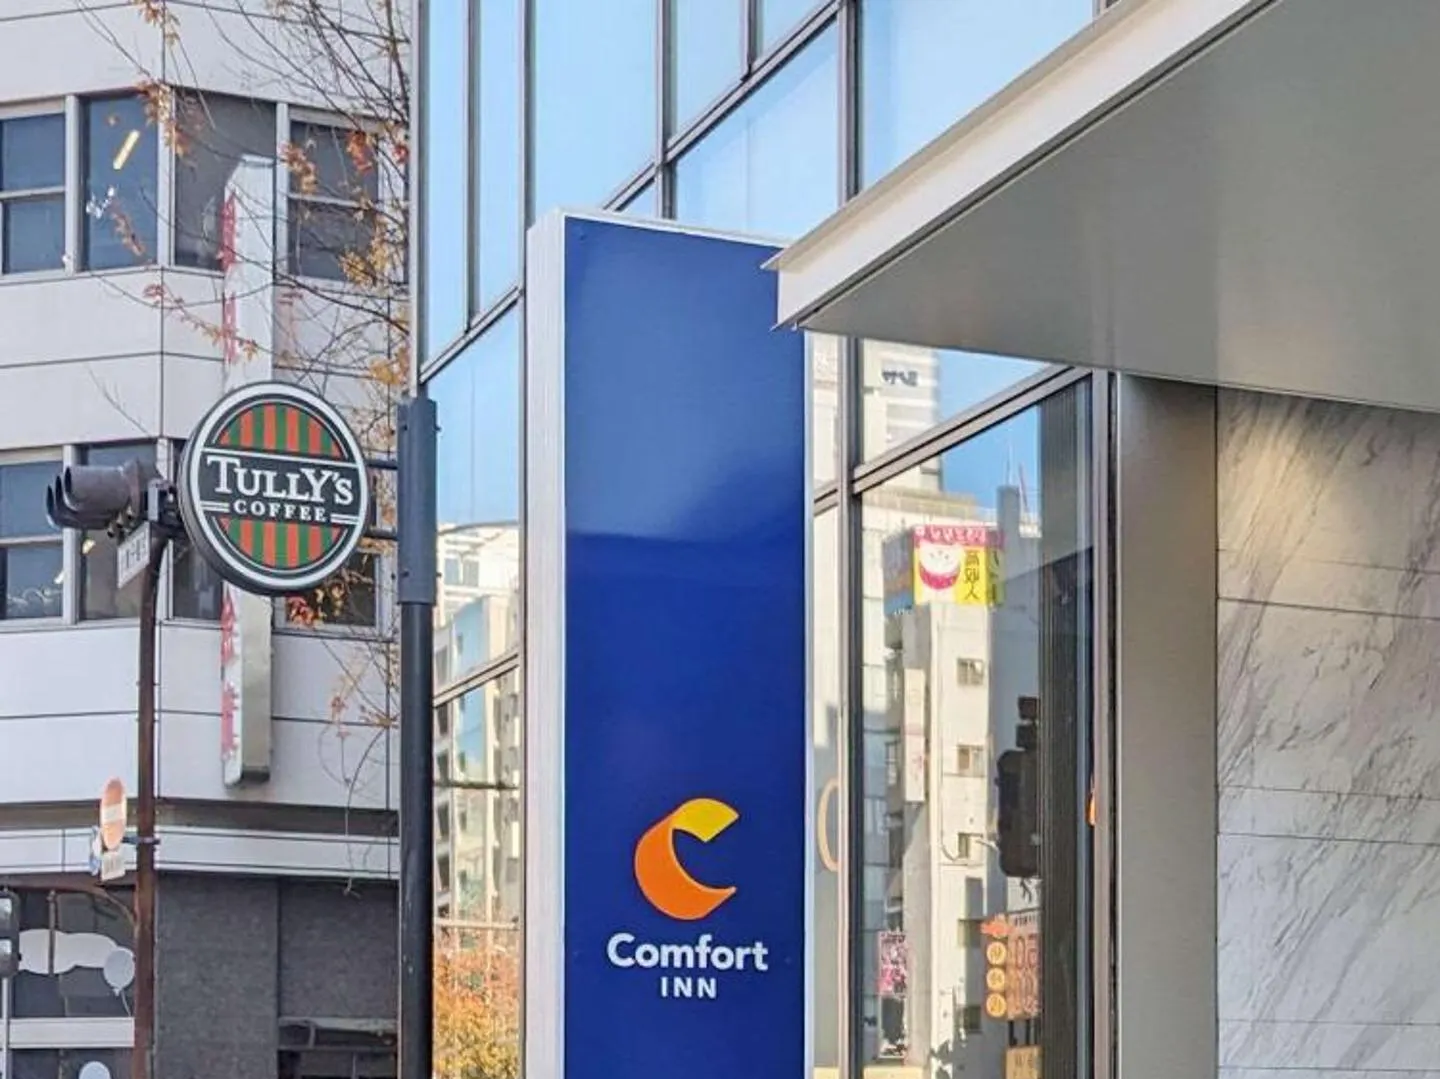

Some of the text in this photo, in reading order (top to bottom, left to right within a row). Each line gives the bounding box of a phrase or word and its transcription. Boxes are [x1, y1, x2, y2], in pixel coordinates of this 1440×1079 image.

[206, 455, 354, 505] TULLY'S
[233, 499, 327, 522] COFFEE
[606, 932, 769, 971] Comfort
[660, 976, 717, 999] INN
